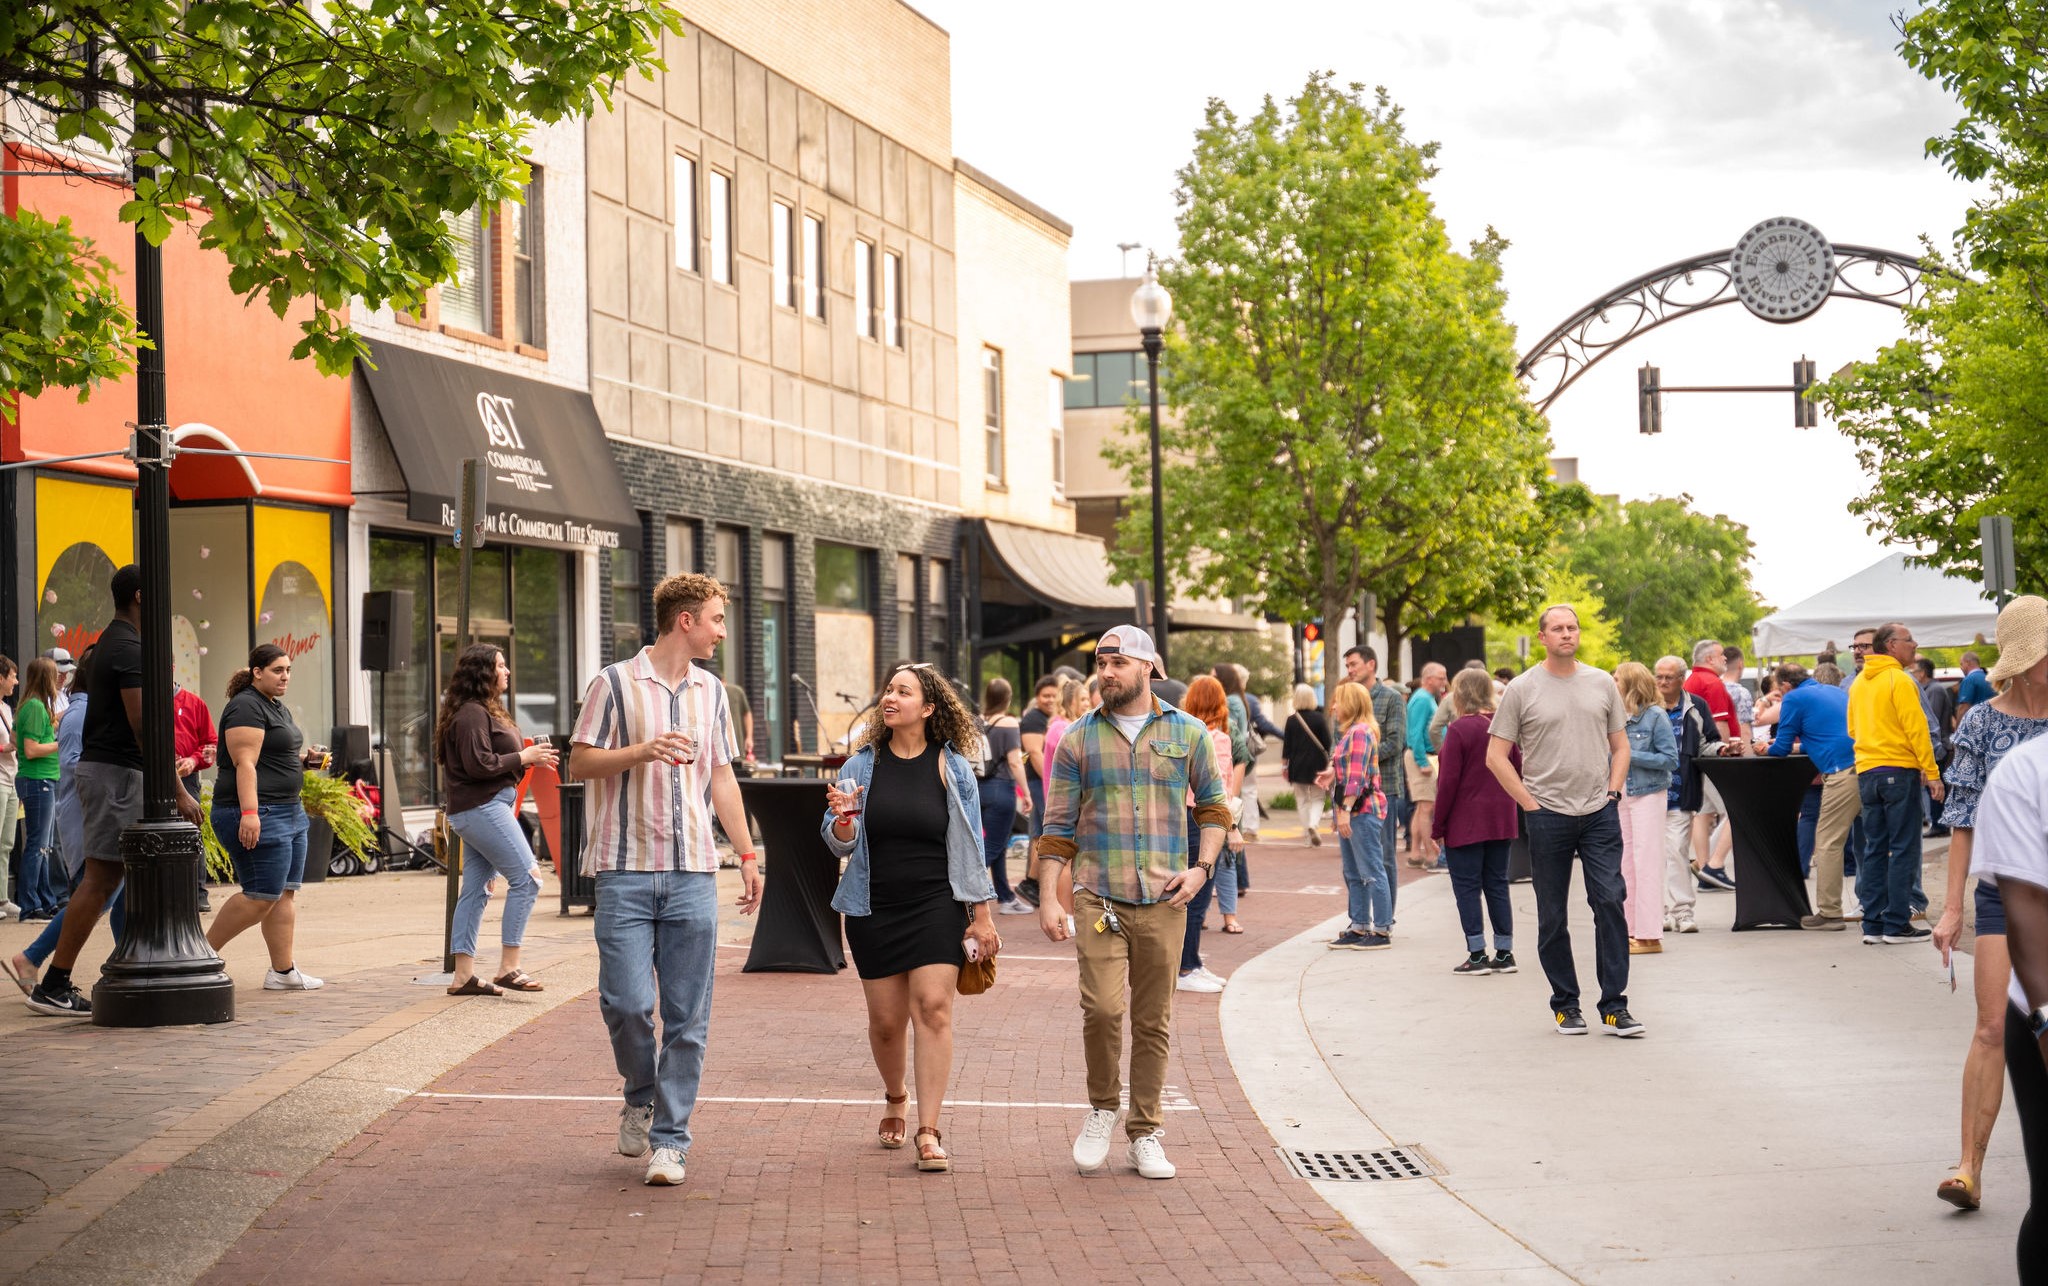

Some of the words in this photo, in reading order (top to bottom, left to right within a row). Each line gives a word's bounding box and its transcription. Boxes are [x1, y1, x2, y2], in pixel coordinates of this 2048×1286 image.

[1746, 234, 1817, 266] Evansville
[1747, 275, 1786, 304] River
[1790, 272, 1819, 300] City
[487, 450, 548, 476] COMMERCIAL
[511, 472, 538, 492] TITLE
[498, 512, 507, 534] &
